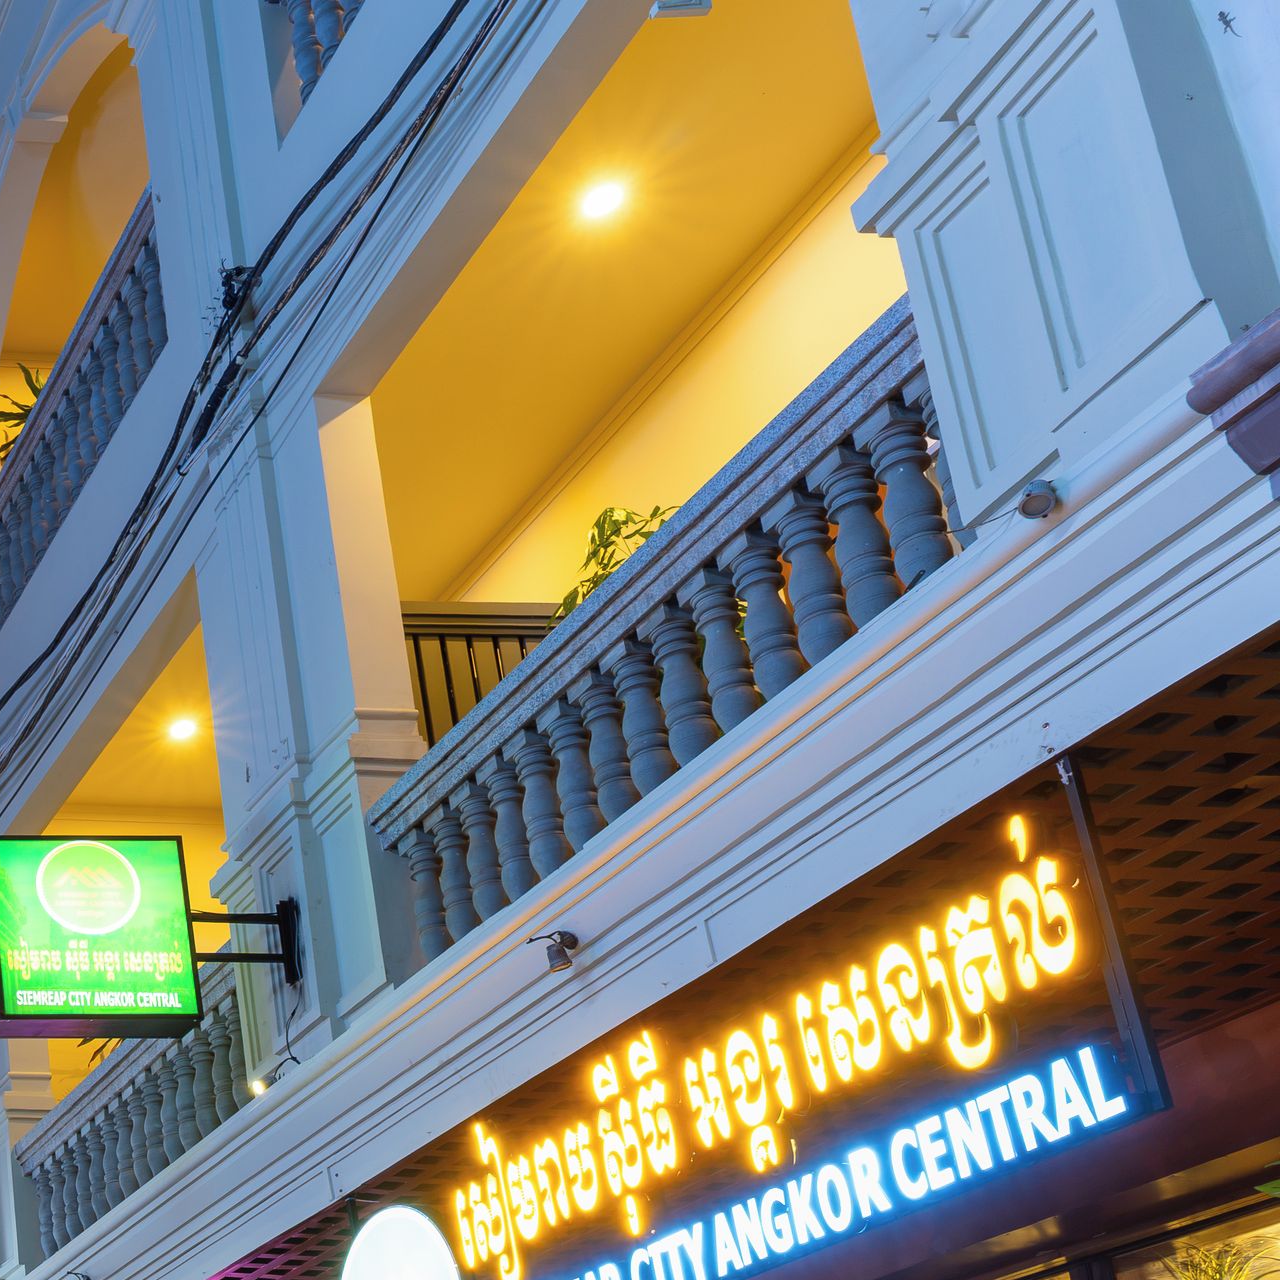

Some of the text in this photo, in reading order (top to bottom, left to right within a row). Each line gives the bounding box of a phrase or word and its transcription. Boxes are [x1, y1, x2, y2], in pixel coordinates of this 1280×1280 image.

[16, 990, 182, 1008] SIEMREAP CITY ANGKOR CENTRAL
[714, 1150, 892, 1279] ANGKOR
[890, 1046, 1127, 1200] CENTRAL
